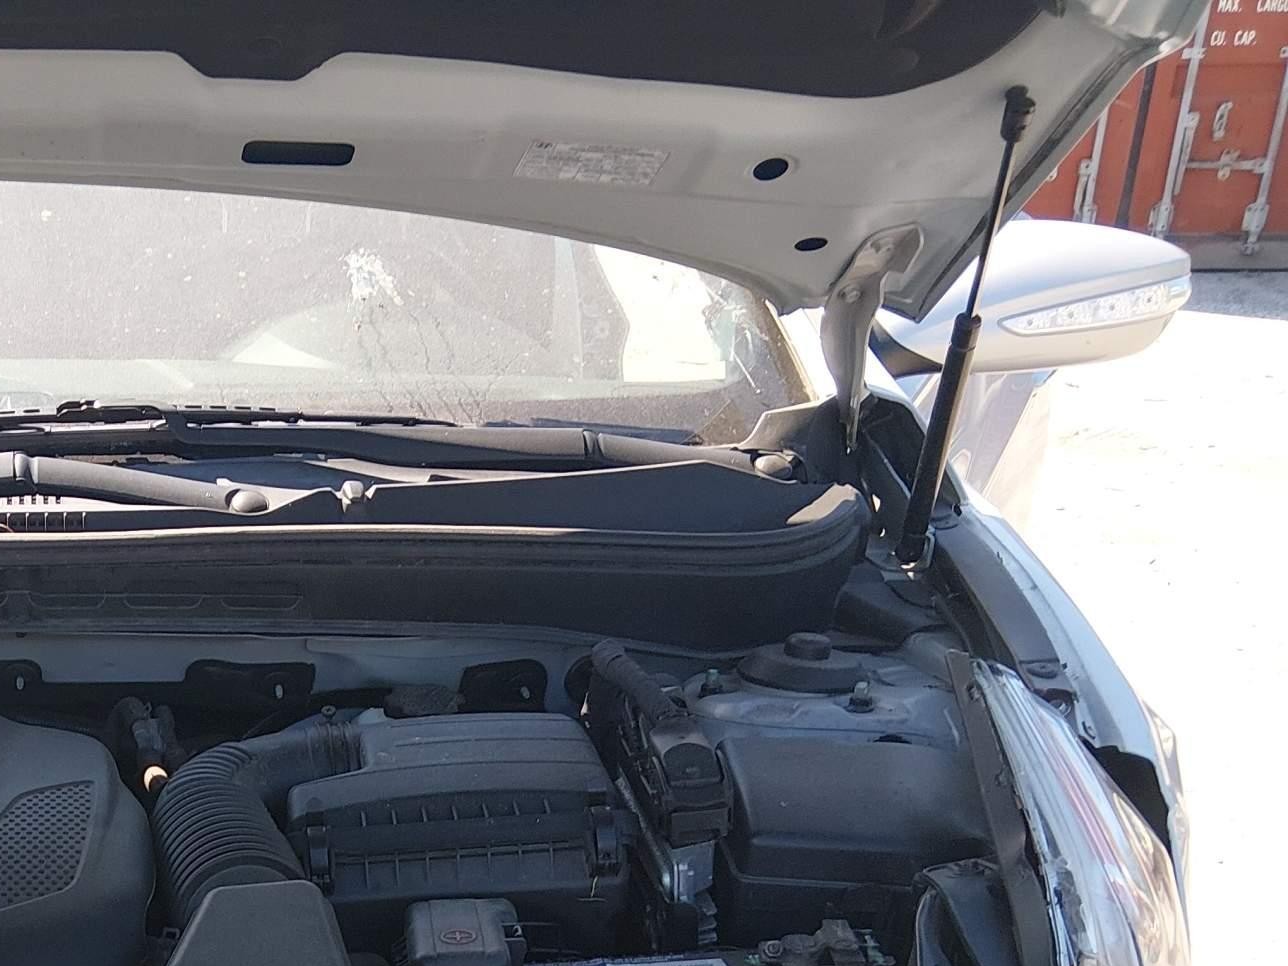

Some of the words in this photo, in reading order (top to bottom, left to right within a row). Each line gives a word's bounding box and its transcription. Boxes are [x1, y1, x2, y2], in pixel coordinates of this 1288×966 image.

[1217, 0, 1242, 13] MAX.
[1210, 30, 1226, 47] CU.
[1234, 30, 1257, 46] CAP.
